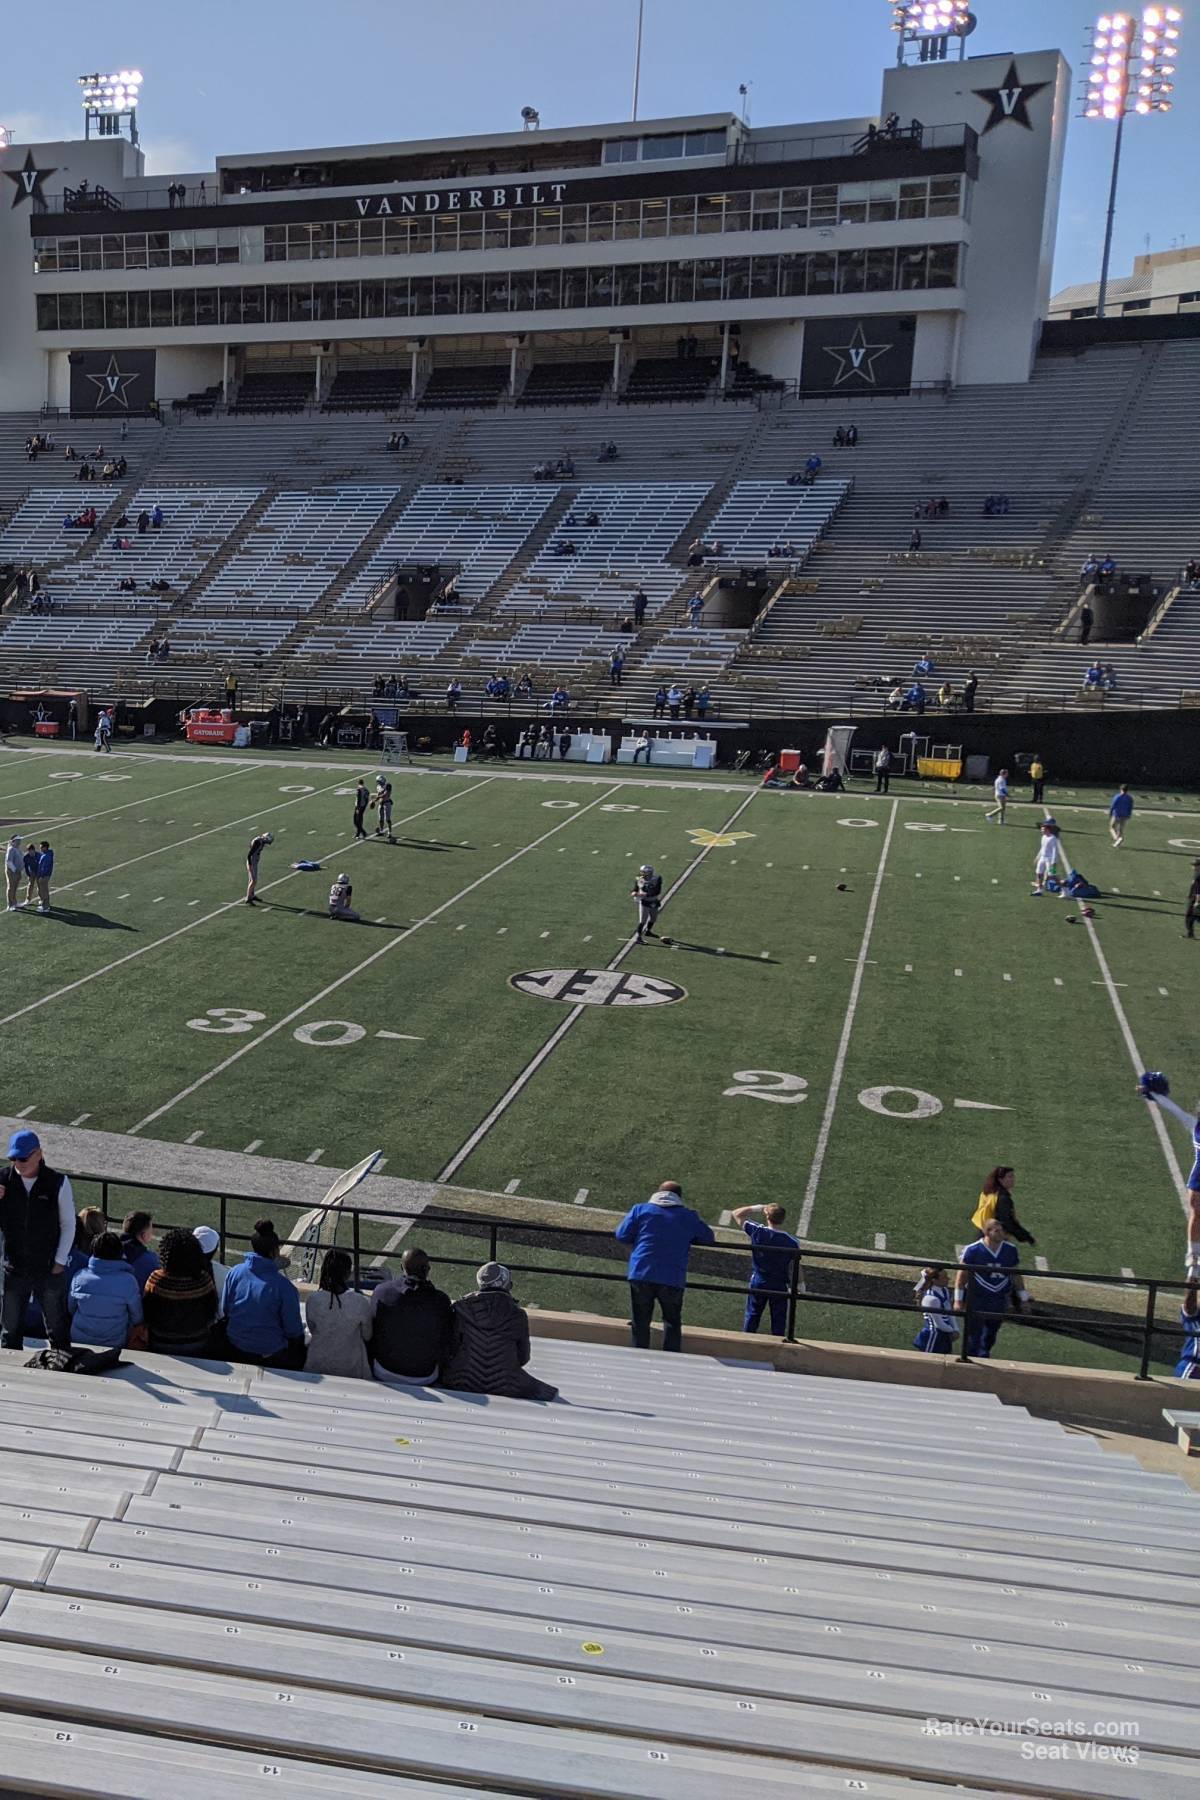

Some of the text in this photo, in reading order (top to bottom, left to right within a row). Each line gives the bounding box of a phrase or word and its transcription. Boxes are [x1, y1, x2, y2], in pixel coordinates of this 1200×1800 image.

[998, 87, 1022, 115] V
[21, 171, 38, 193] V
[355, 184, 567, 216] VANDERBILT
[848, 348, 867, 368] V
[106, 376, 120, 393] V
[193, 729, 225, 737] GATORADE
[186, 1007, 367, 1046] 30
[722, 1069, 944, 1119] 20
[278, 1693, 292, 1702] 14
[738, 1702, 753, 1710] 16
[459, 1722, 475, 1731] 15
[55, 1732, 72, 1742] 13
[649, 1751, 666, 1760] 16
[263, 1765, 279, 1775] 14
[848, 1780, 865, 1789] 17
